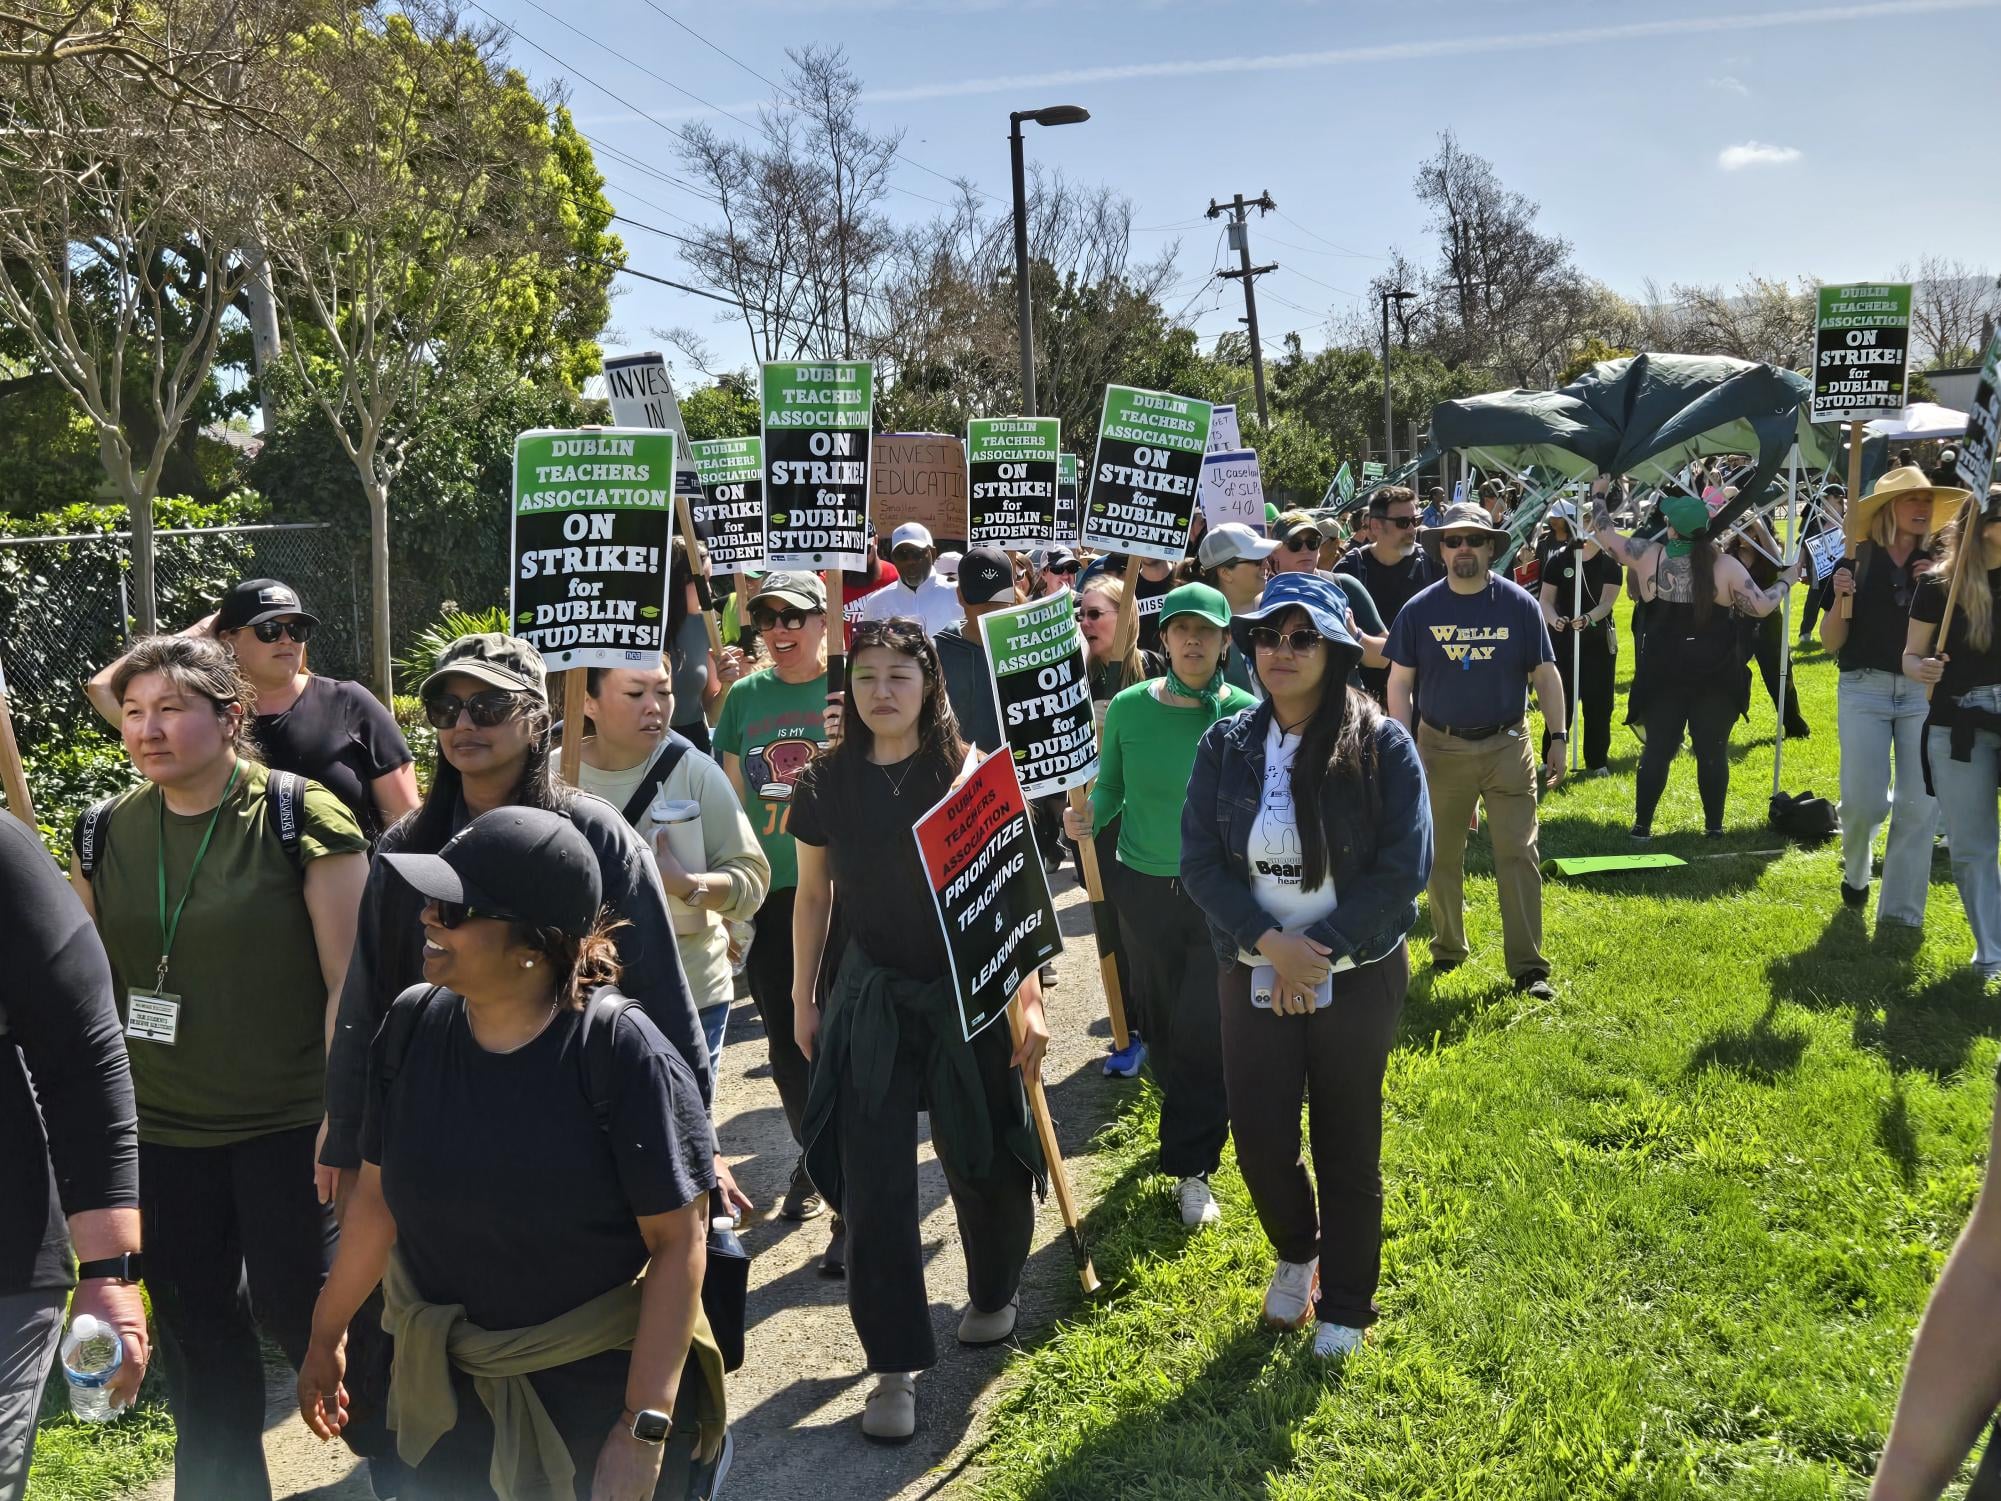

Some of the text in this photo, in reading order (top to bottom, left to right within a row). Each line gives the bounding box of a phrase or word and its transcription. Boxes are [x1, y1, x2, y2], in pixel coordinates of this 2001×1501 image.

[1840, 287, 1889, 298] DUBLIN
[1830, 302, 1898, 312] TEACHERS
[1820, 316, 1908, 328] ASSOCIATION
[1845, 330, 1878, 346] ON
[1820, 349, 1903, 367] STRIKE!
[1848, 368, 1870, 379] for
[1828, 380, 1889, 393] DUBLIN
[1132, 394, 1188, 414] DUBLIN
[1815, 394, 1902, 409] STUDENTS!
[767, 410, 869, 426] ASSOCIATION
[990, 422, 1037, 432] DUBLIN
[1120, 409, 1196, 433] TEACHERS
[809, 431, 851, 457] ON
[981, 436, 1046, 447] TEACHERS
[1103, 424, 1204, 451] ASSOCIATION
[551, 439, 636, 457] DUBLIN
[702, 442, 747, 455] DUBLIN
[872, 444, 948, 465] INVEST
[971, 450, 1055, 461] ASSOCIATION
[1133, 446, 1171, 469] ON
[696, 455, 755, 470] TEACHERS
[997, 463, 1028, 479] ON
[535, 464, 650, 483] TEACHERS
[771, 460, 865, 485] STRIKE!
[1098, 463, 1195, 496] STRIKE!
[715, 484, 745, 502] ON
[816, 488, 846, 506] for
[973, 482, 1052, 499] STRIKE!
[1131, 491, 1157, 507] for
[1225, 482, 1236, 497] of
[518, 488, 667, 511] ASSOCIATION
[1002, 500, 1022, 511] for
[693, 501, 763, 523] STRIKE
[983, 512, 1041, 525] DUBLIN
[1106, 502, 1177, 527] DUBLIN
[563, 513, 616, 541] ON
[723, 522, 745, 532] for
[971, 525, 1053, 540] STUDENTS!
[1087, 516, 1187, 546] STUDENTS!
[706, 532, 762, 549] DUBLIN
[768, 530, 864, 550] STUDENTS!
[520, 545, 660, 580] STRIKE!
[567, 577, 604, 598] for
[535, 599, 637, 625] DUBLIN
[1015, 598, 1068, 629] DUBLIN
[996, 632, 1081, 674] ASSOCIATIO
[1037, 659, 1072, 691] ON
[1006, 675, 1089, 726] STRIKE
[777, 727, 805, 737] IS MY
[1052, 716, 1076, 735] for
[1028, 720, 1092, 760] DUBLIN
[946, 777, 984, 821] DUBLIN
[943, 789, 996, 848] TEACHERS
[942, 802, 1010, 877] ASSOCIATION
[945, 816, 1024, 908] PRIORITIZE
[957, 852, 1025, 933] TEACHING
[994, 911, 1003, 933] &
[971, 908, 1042, 996] LEARNING!
